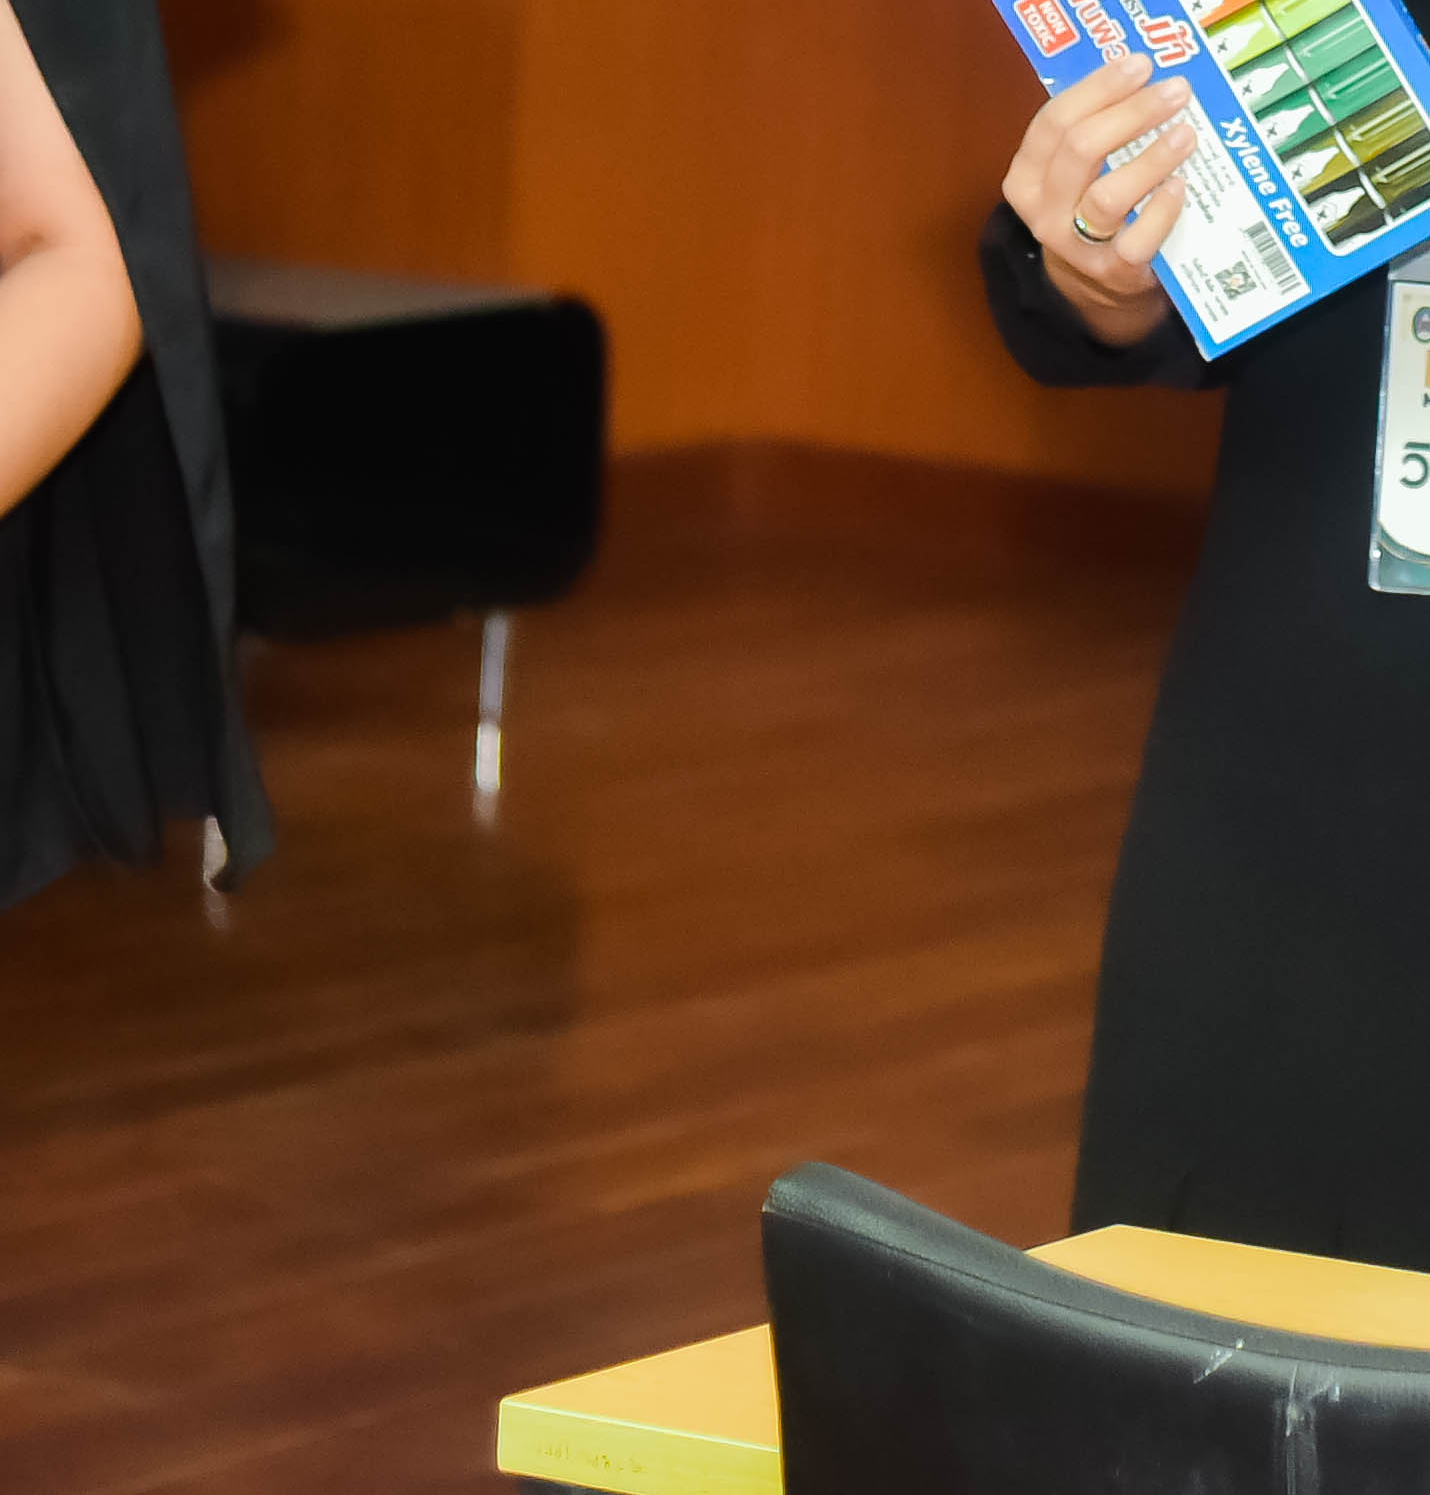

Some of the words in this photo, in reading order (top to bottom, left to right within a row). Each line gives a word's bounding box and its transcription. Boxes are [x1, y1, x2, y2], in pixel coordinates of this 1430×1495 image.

[1023, 4, 1056, 47] TOXIC
[1039, 0, 1067, 35] NON
[1220, 117, 1277, 196] Xylene
[1268, 198, 1308, 248] Free
